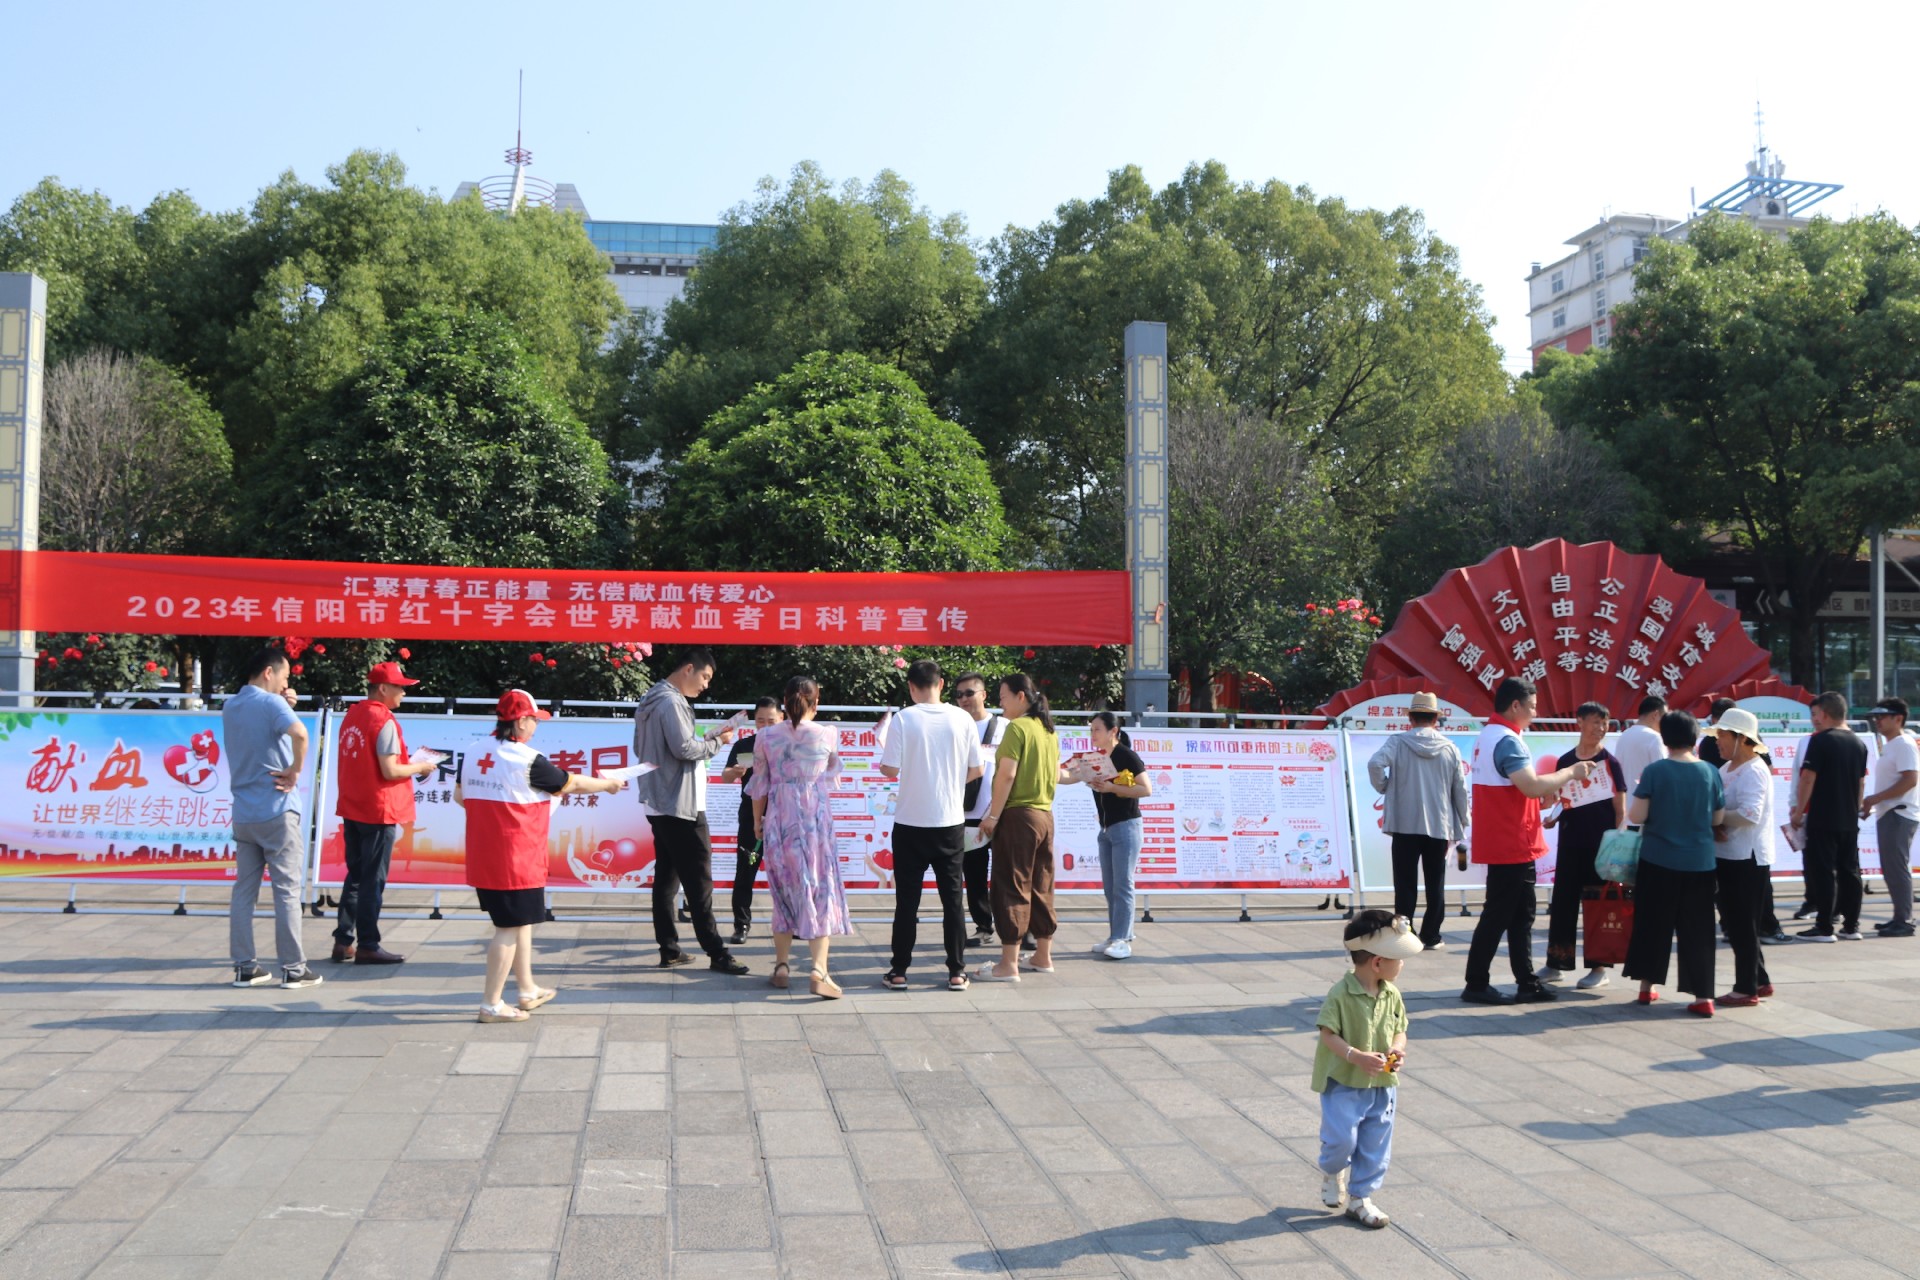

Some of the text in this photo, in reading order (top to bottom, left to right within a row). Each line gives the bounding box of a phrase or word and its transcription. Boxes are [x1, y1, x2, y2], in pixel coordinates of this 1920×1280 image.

[127, 594, 969, 633] 2023年信阳市红十字会世界献血者日科普宣传
[343, 576, 775, 604] 汇聚青春正能量 无偿献血传爱心
[1491, 588, 1547, 684] 文明和谐
[1549, 572, 1583, 673] 自由平等
[1584, 576, 1626, 674] 公正法治
[1615, 595, 1674, 690] 爱国敬业
[1645, 621, 1718, 699] 诚信友善
[26, 737, 149, 793] 献血
[840, 730, 875, 747] 爱心
[1133, 738, 1173, 752] 的血液
[33, 794, 235, 828] 让世界继续跳动
